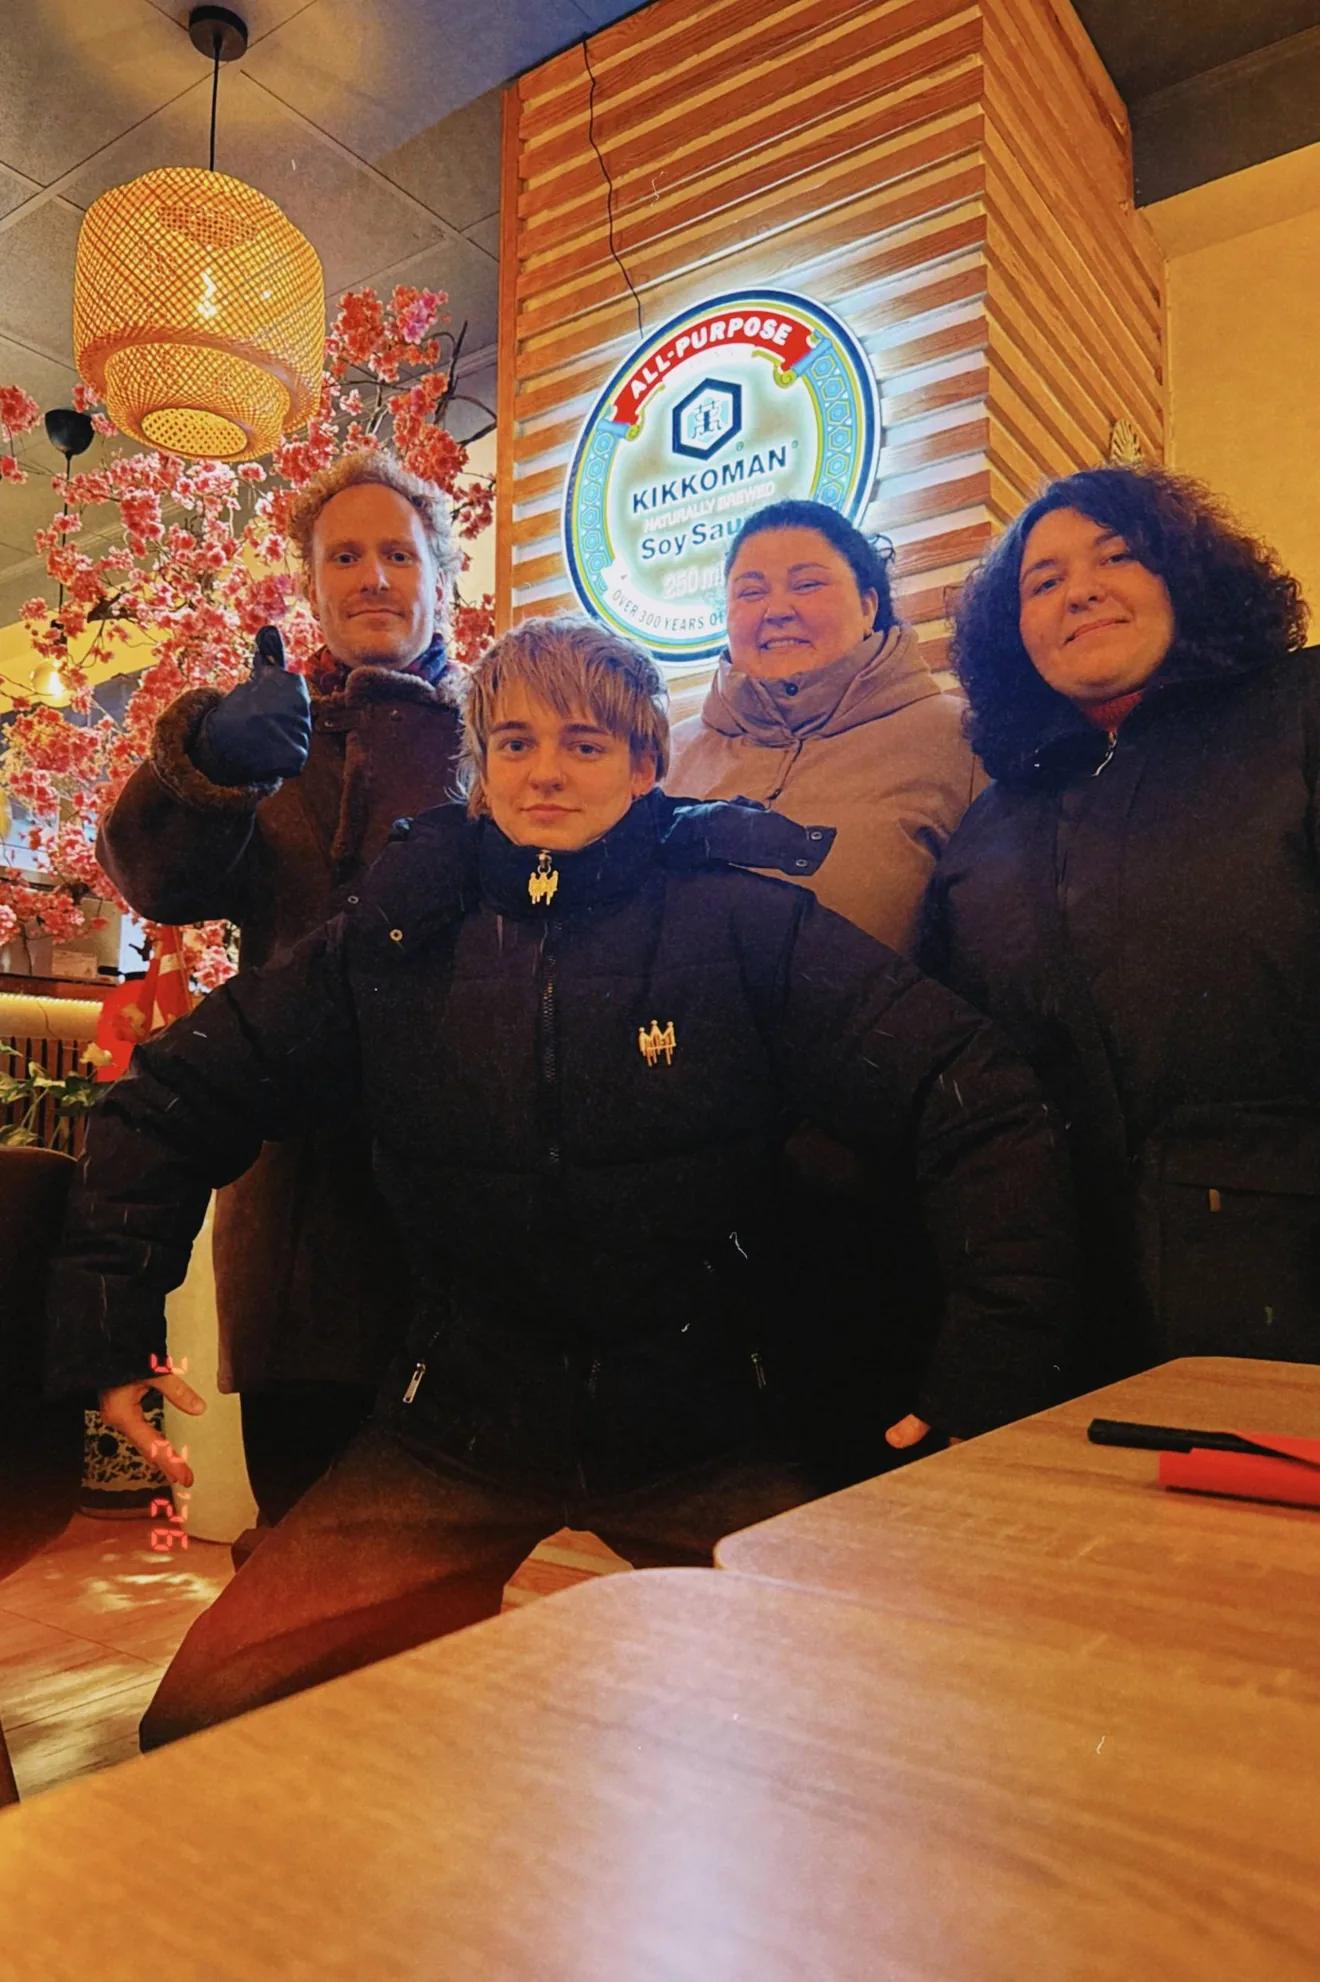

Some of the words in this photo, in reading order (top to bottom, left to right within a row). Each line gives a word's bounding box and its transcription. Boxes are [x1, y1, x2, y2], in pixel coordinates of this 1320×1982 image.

[630, 317, 793, 400] ALL-PURPOSE
[632, 445, 788, 514] KIKKOMAN
[643, 496, 717, 534] NATURALLY
[641, 534, 687, 561] Soy
[691, 517, 743, 546] Sau
[663, 565, 699, 599] 250
[611, 589, 639, 617] OVER
[638, 610, 661, 629] 300
[663, 615, 705, 632] YEARS
